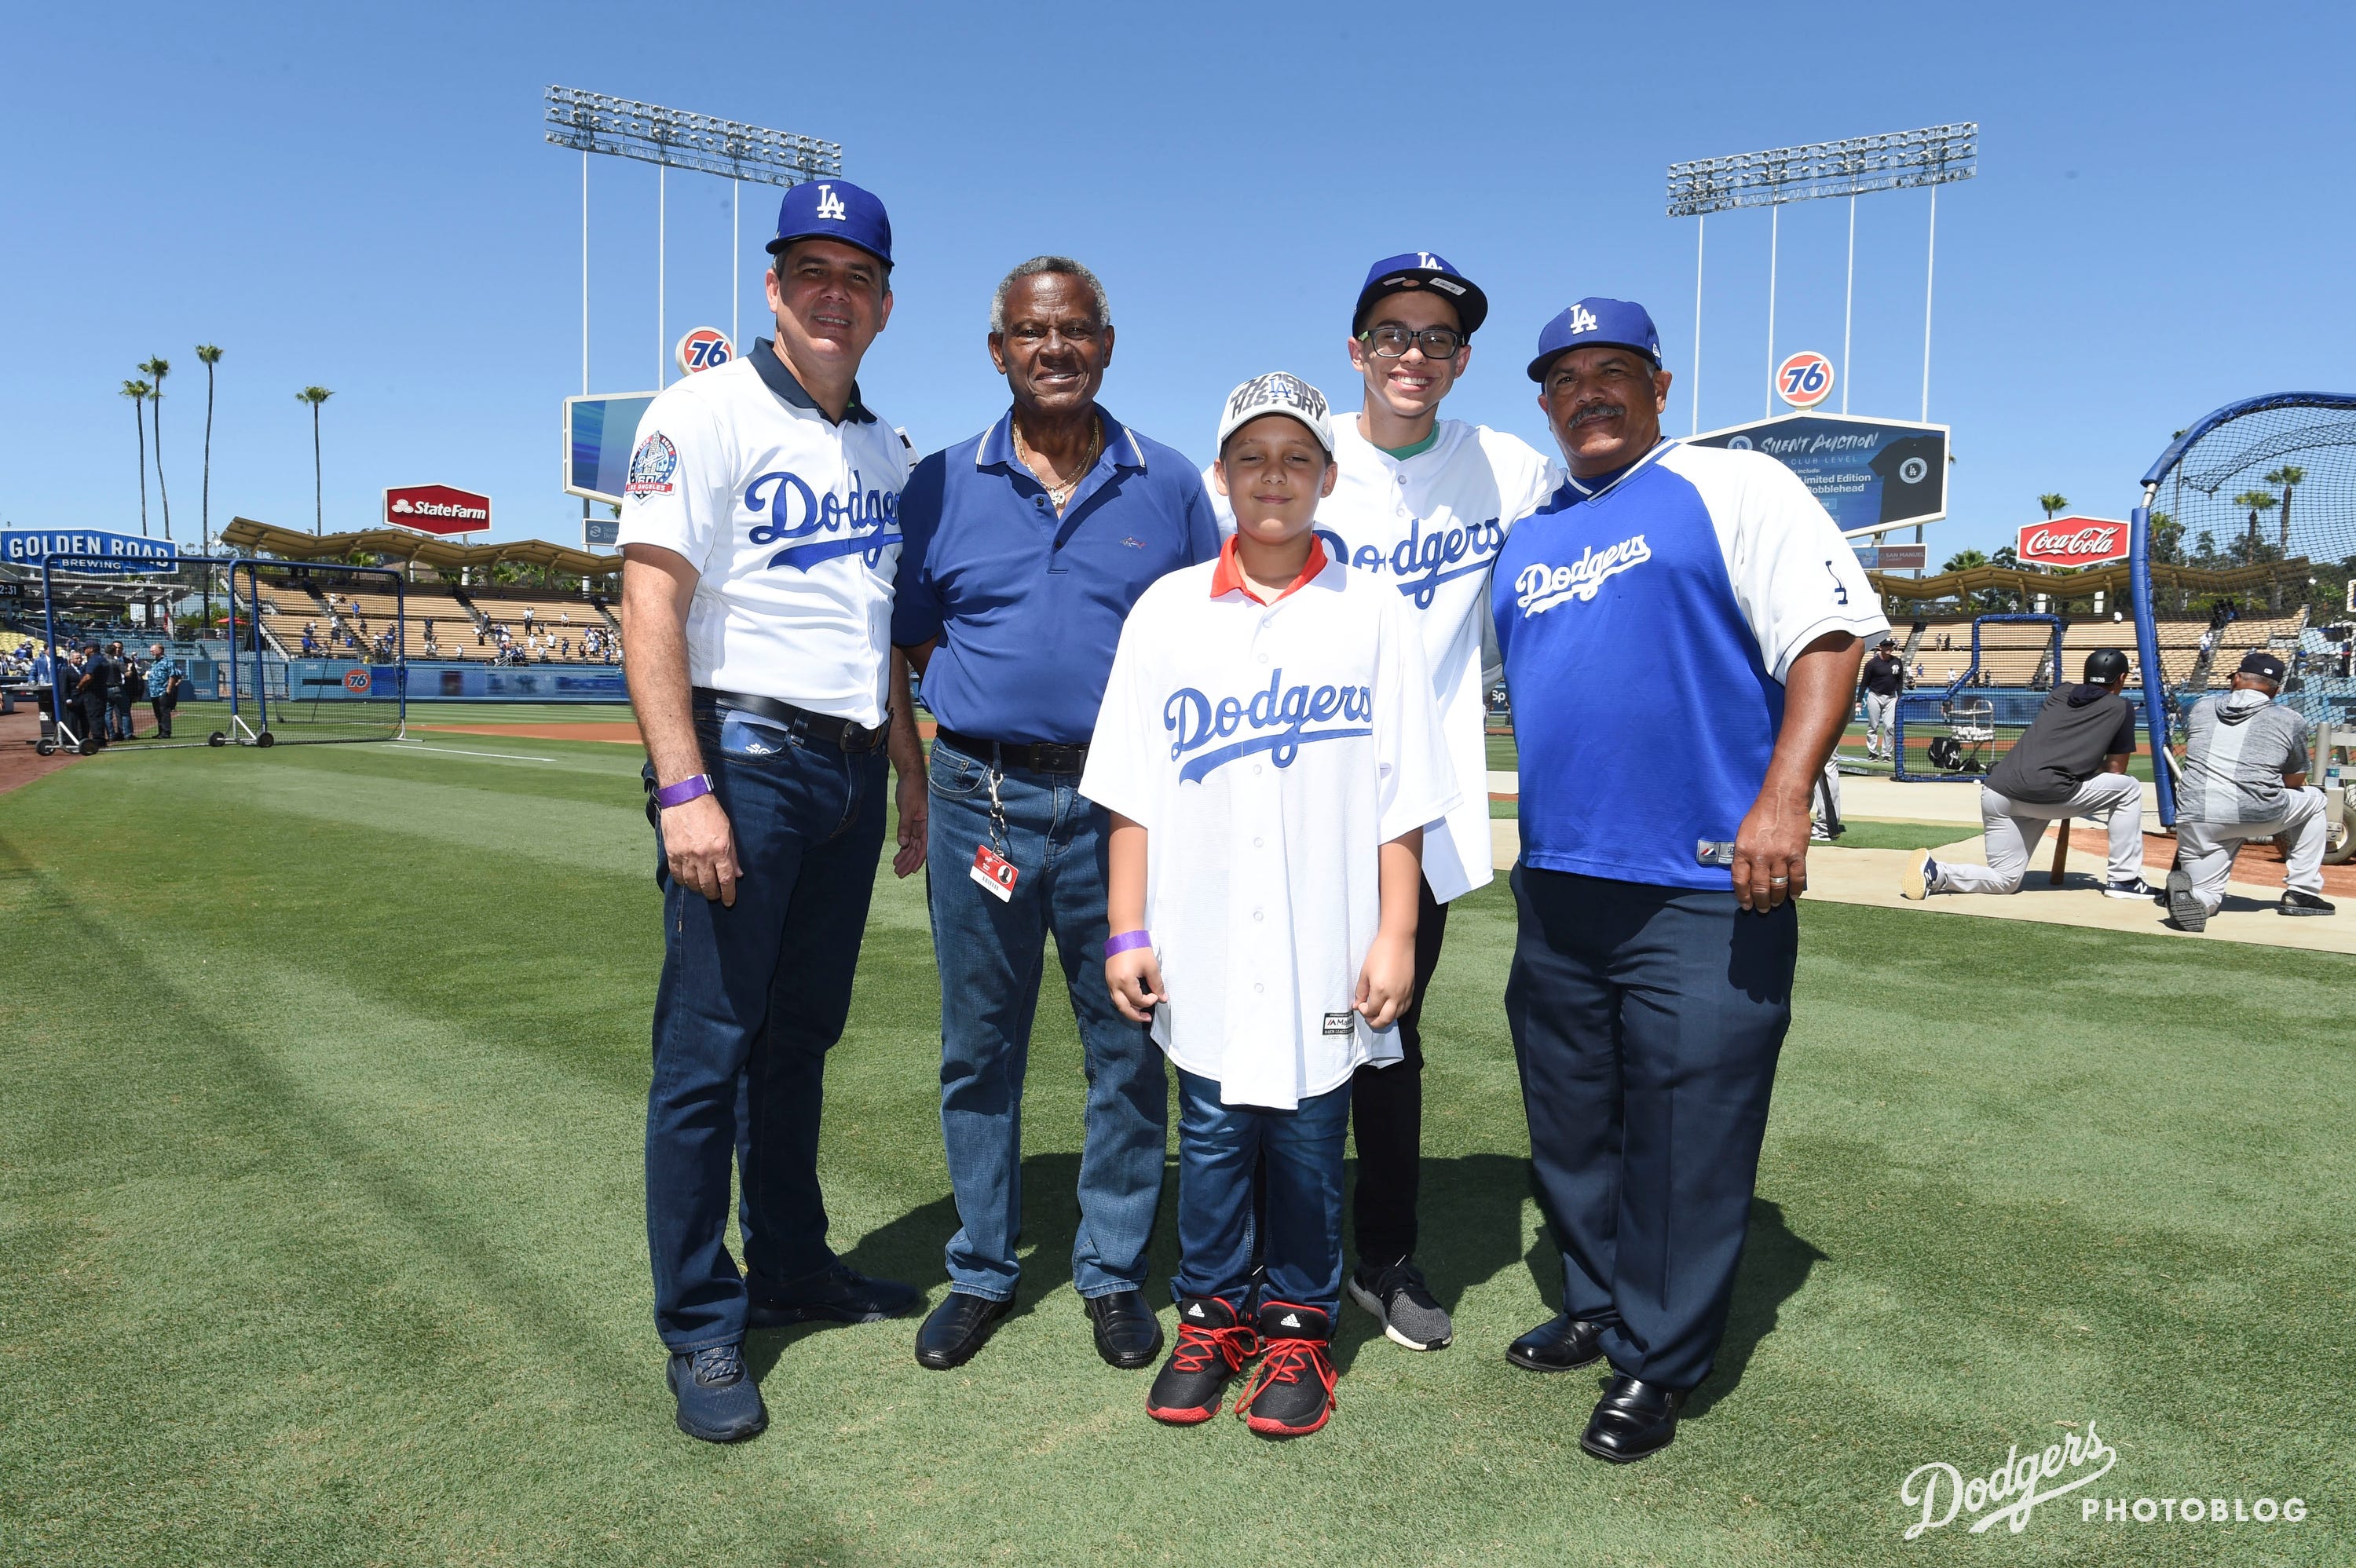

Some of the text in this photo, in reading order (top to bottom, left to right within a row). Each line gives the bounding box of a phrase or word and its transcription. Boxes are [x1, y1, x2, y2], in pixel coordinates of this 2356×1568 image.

[817, 185, 846, 221] LA
[1570, 303, 1598, 335] LA
[687, 338, 730, 369] 76
[1269, 378, 1292, 398] LA
[1783, 360, 1827, 395] 76
[1231, 389, 1326, 422] HISORY
[1760, 437, 1811, 455] SILENT
[1809, 432, 1879, 454] AUCTION
[1791, 457, 1818, 466] CLUB
[1837, 473, 1871, 483] Edition
[9, 535, 169, 568] GOLDEN ROAD
[2025, 526, 2120, 556] Coca-Cola
[62, 559, 122, 569] BREWING
[1515, 533, 1652, 618] Dodgers
[348, 674, 368, 688] 76
[1163, 668, 1373, 787] Dodgers
